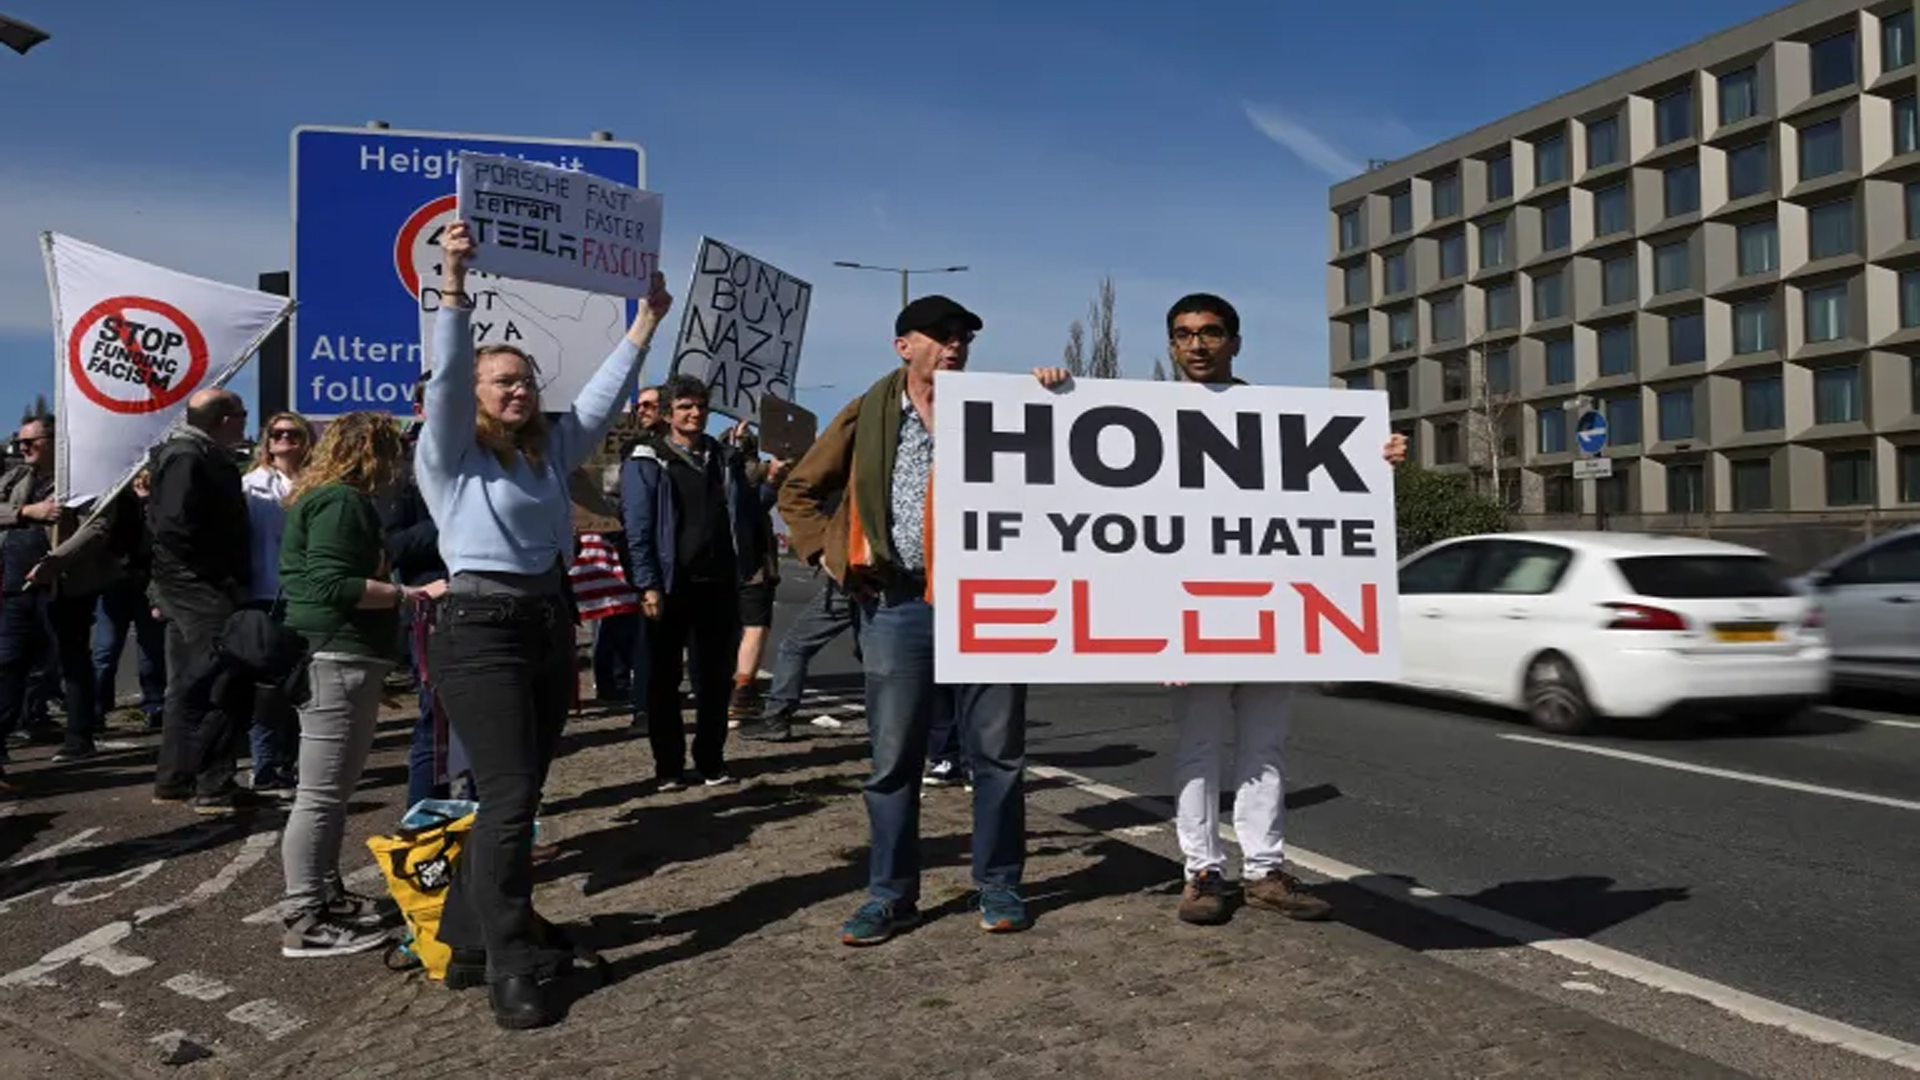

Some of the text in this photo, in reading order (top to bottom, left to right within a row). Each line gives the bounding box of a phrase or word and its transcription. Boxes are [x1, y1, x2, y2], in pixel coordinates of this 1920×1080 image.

[361, 145, 461, 179] Heigh
[474, 162, 569, 199] PORSCHE
[587, 183, 631, 211] FAST
[474, 189, 644, 243] Ferrari FASTER
[471, 215, 577, 260] TESLA
[582, 237, 659, 281] FASCIST
[711, 277, 794, 335] BUY
[92, 341, 179, 375] FUNDING
[99, 316, 183, 355] STOP
[310, 335, 421, 362] Altern
[685, 304, 793, 379] NAZI
[87, 356, 172, 390] FACISM
[963, 400, 1371, 493] HONK
[963, 511, 1377, 557] IF YOU HATE
[958, 579, 1380, 654] ELON
